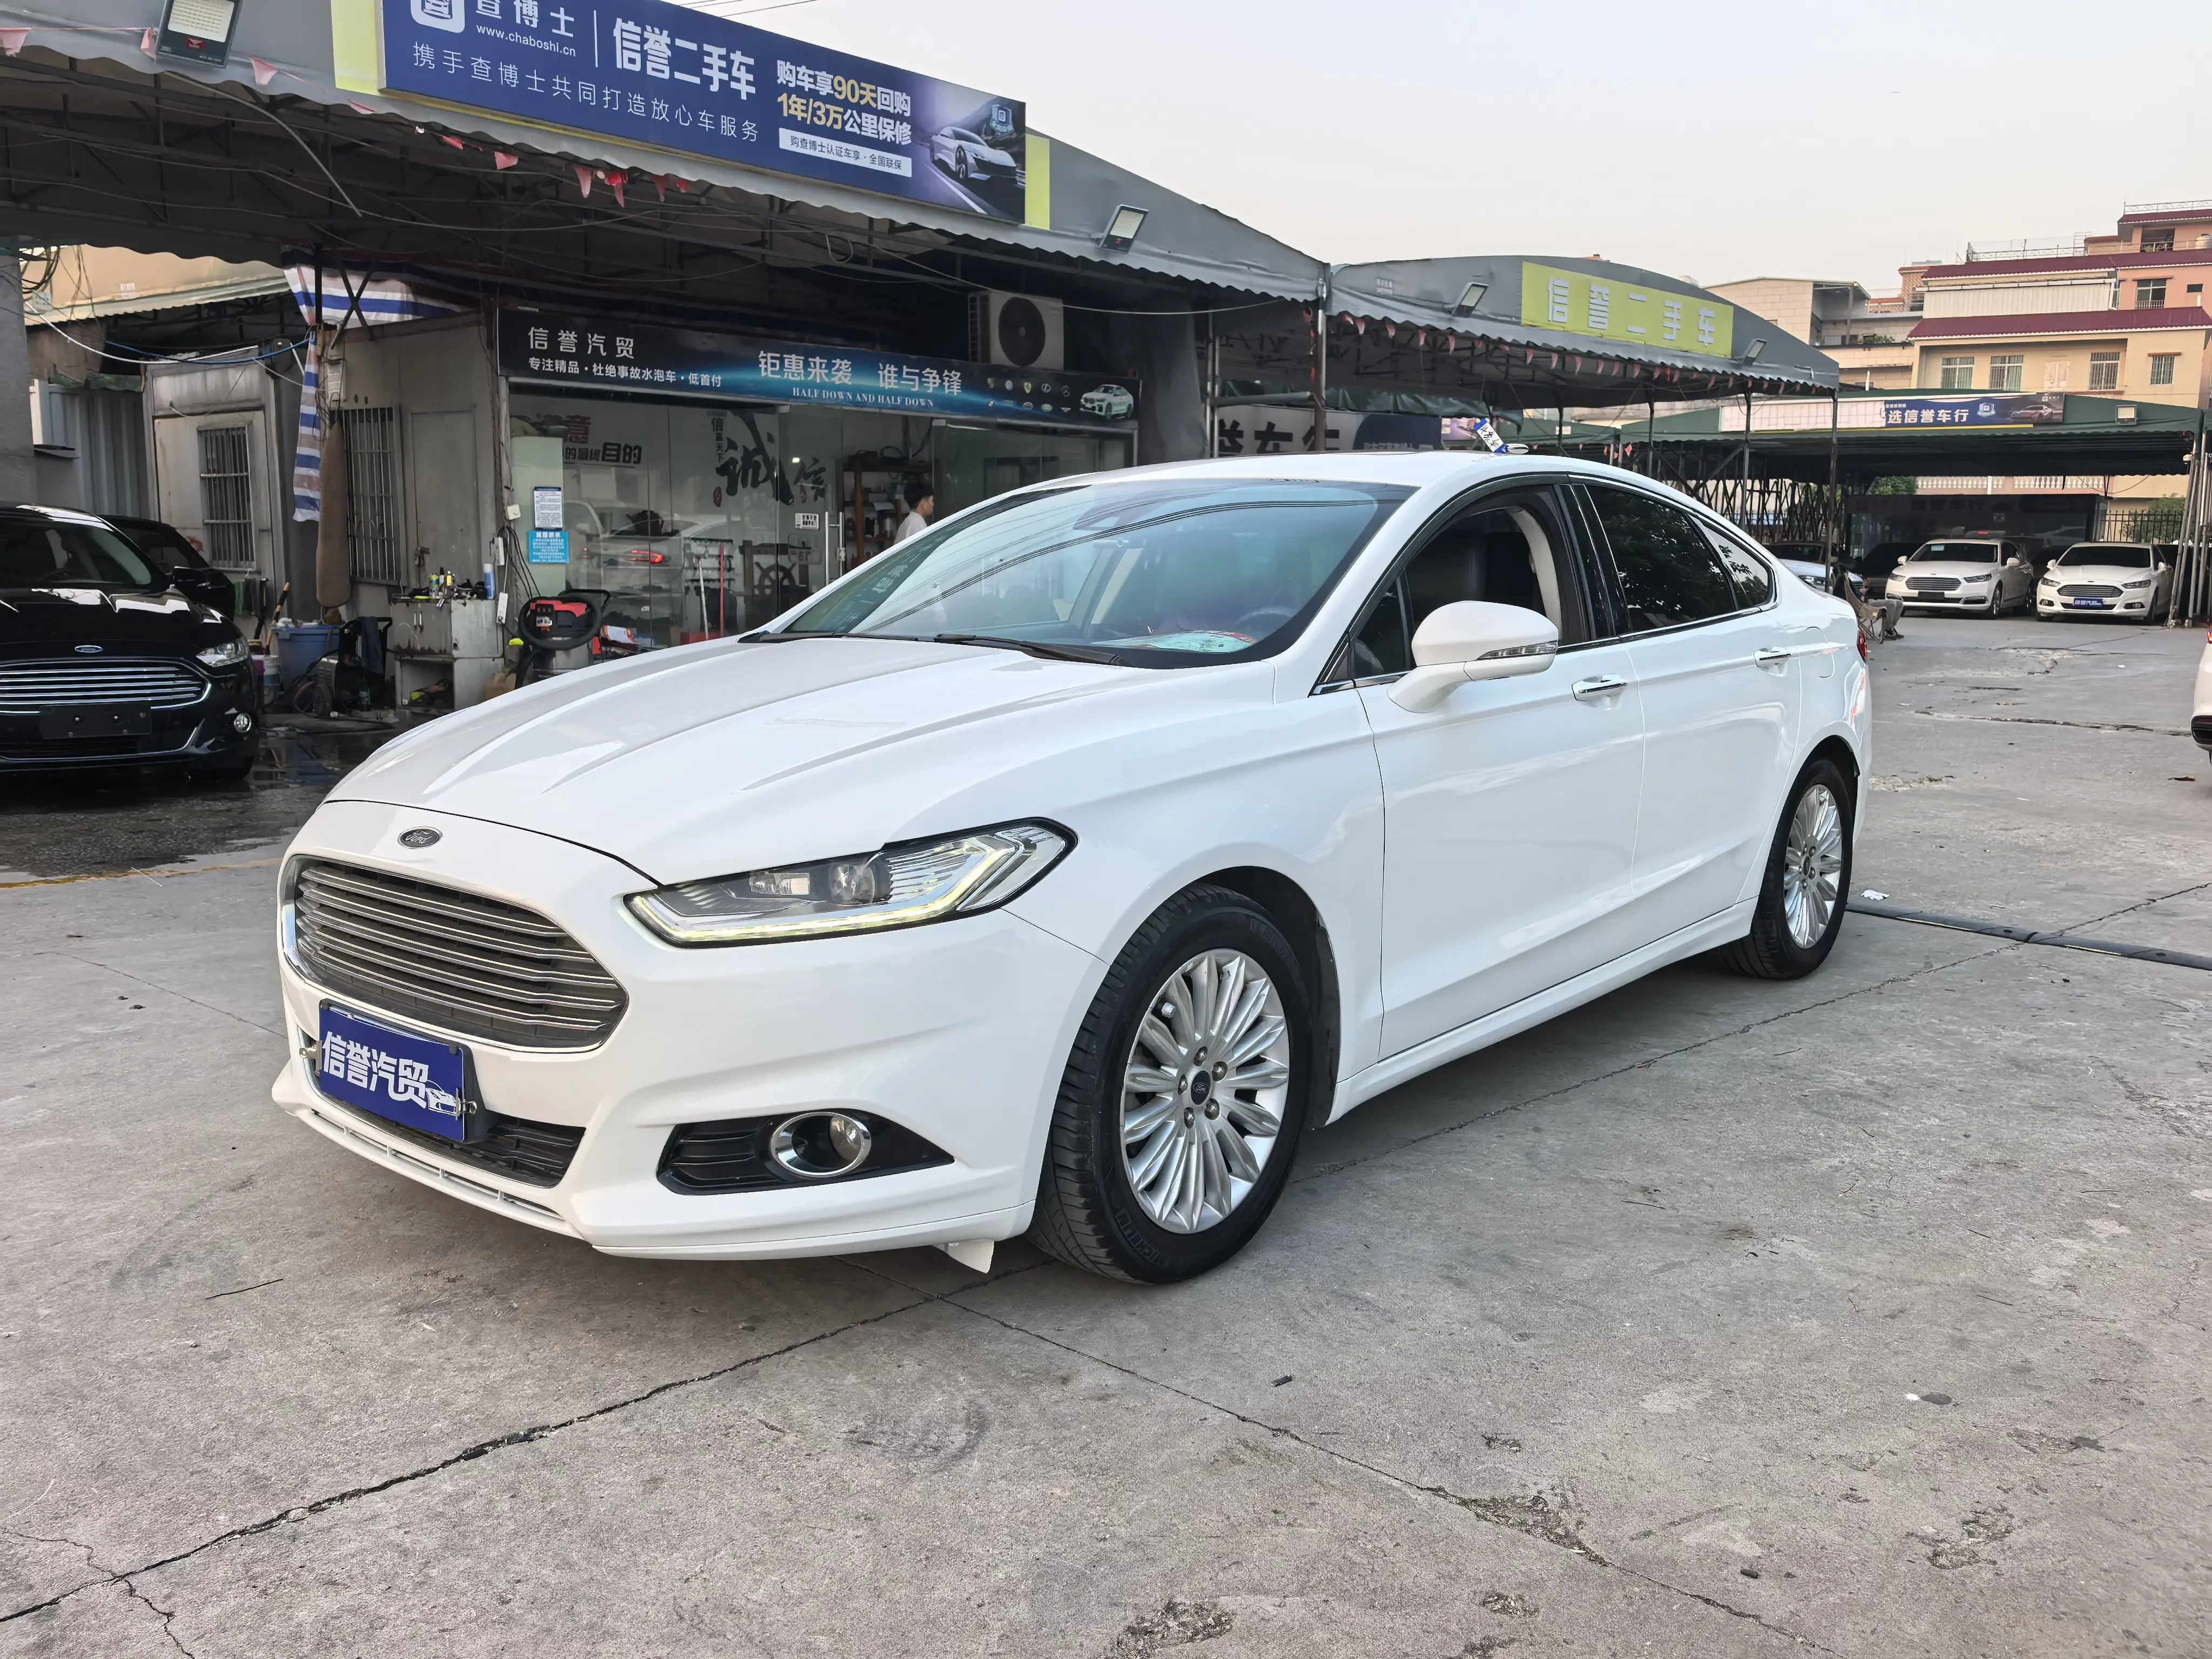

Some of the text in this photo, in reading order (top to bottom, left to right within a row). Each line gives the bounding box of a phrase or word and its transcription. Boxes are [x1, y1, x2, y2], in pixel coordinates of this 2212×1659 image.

[476, 0, 575, 37] 查博士
[476, 25, 576, 57] www.chaboshi.cn
[613, 18, 756, 100] 信誉二手车
[413, 41, 758, 141] 携手查博士共同打造放心车服务
[777, 60, 911, 117] 购车享90天回购
[778, 93, 912, 145] 1年/3万公里保修
[1548, 275, 1716, 347] 信誉二手车
[528, 327, 634, 359] 信誉汽贸
[758, 350, 962, 395] 钜惠来袭 谁与争锋
[792, 387, 934, 407] HALF DOWN AND HALF DOWN
[405, 831, 433, 844] Ford
[322, 1031, 429, 1109] 信誉汽贸
